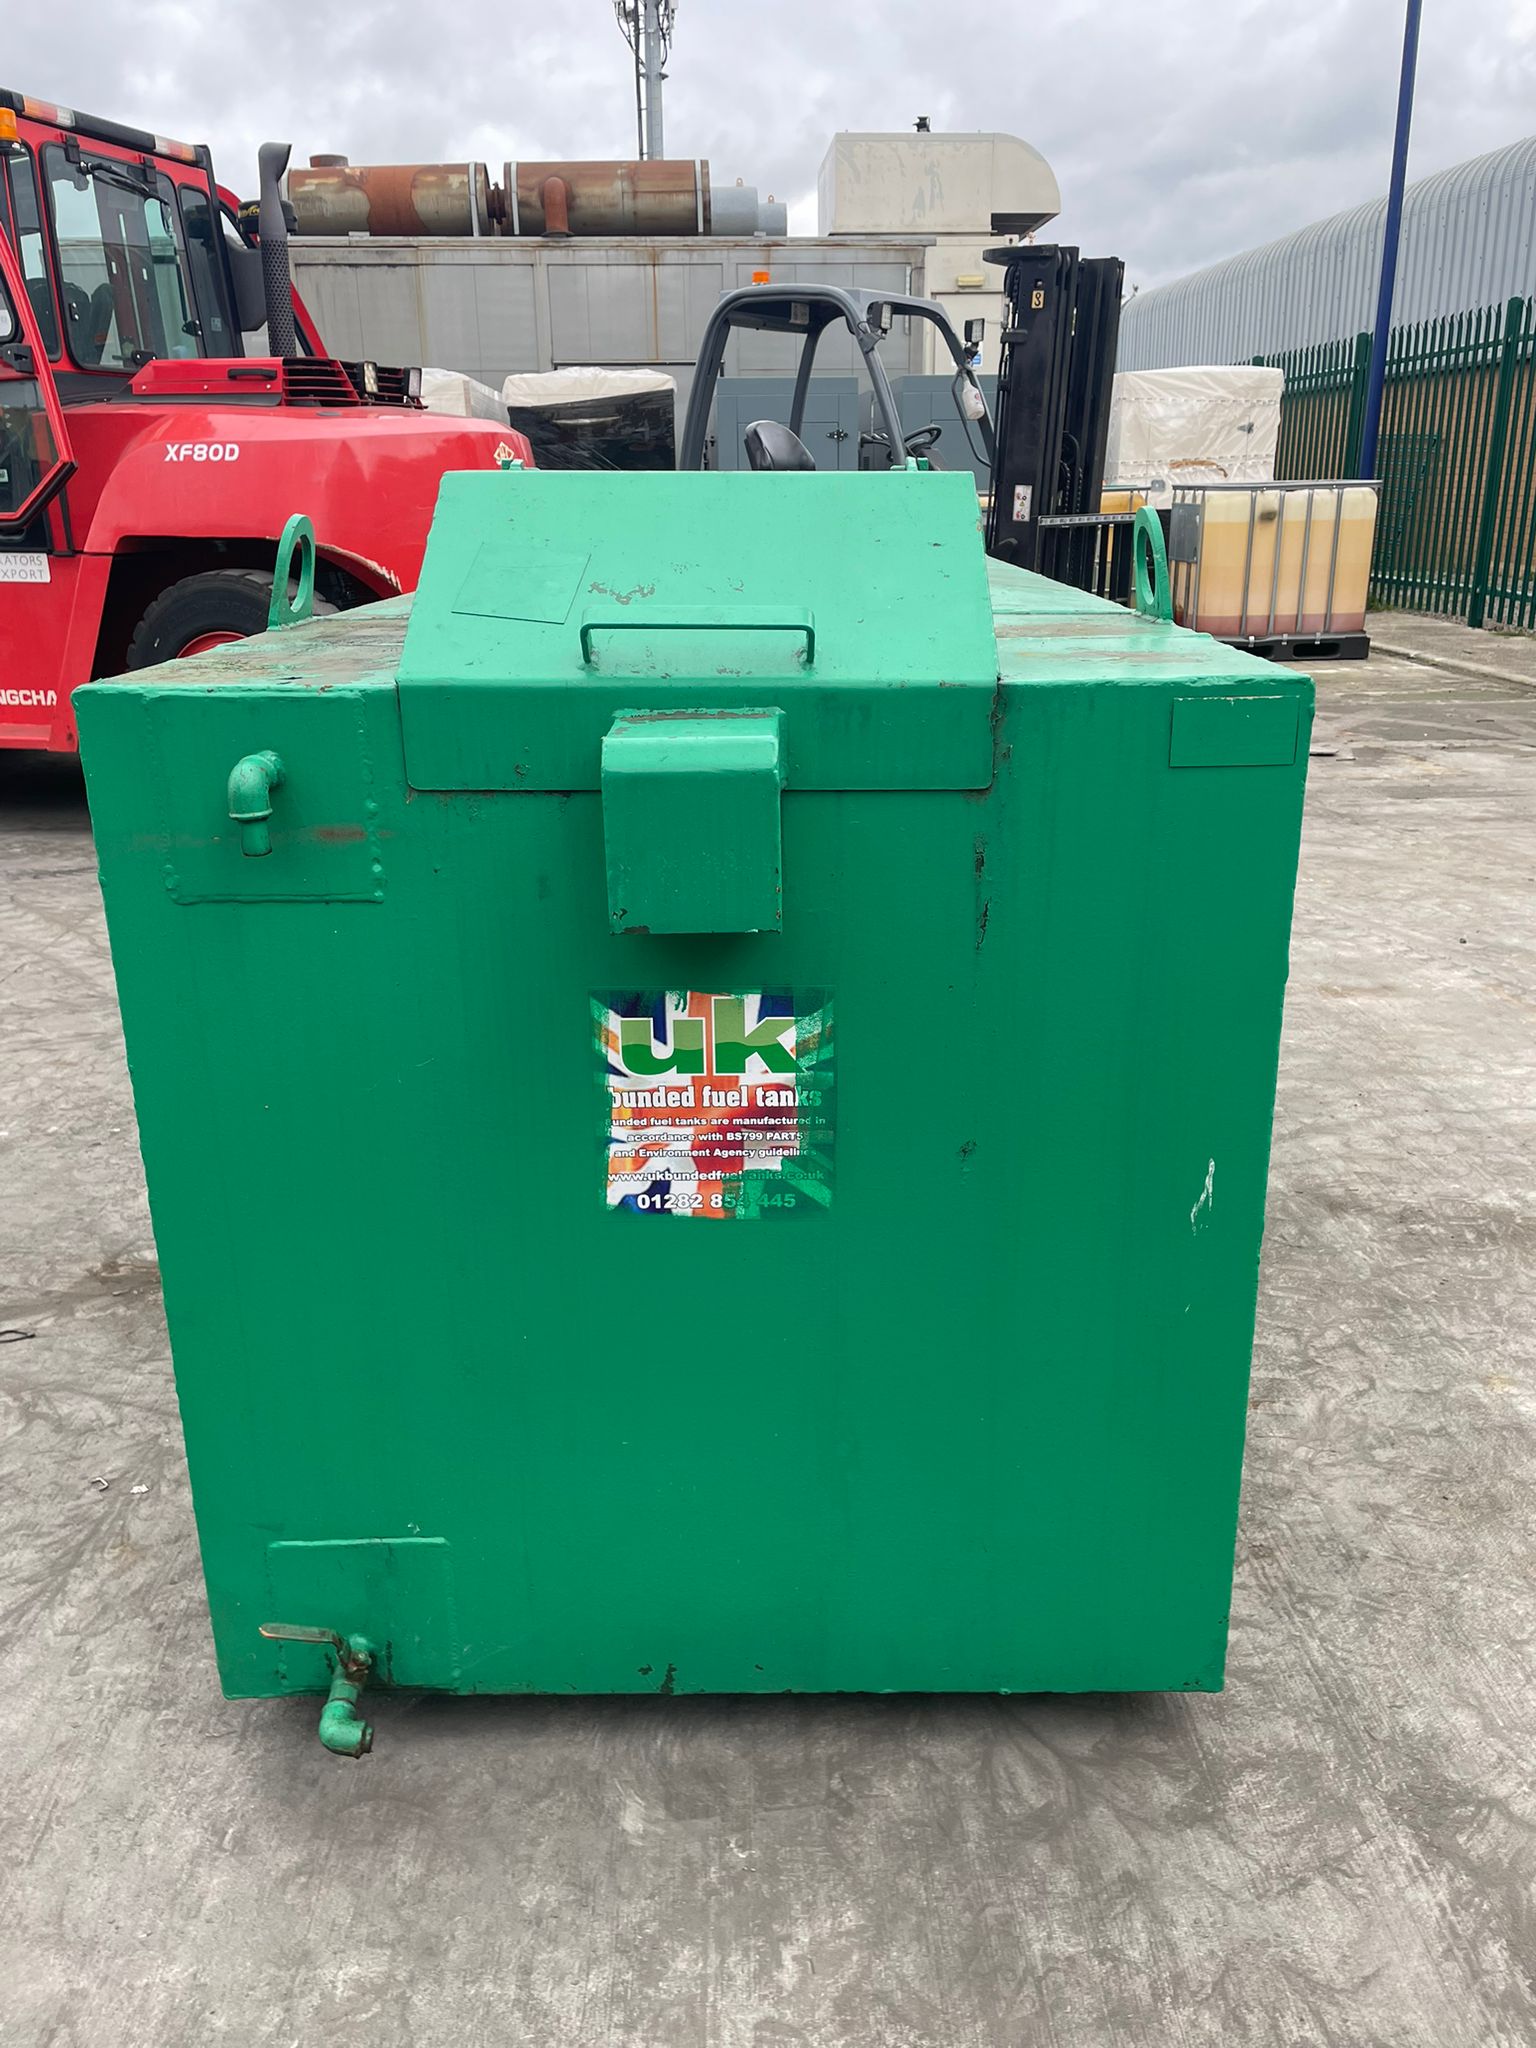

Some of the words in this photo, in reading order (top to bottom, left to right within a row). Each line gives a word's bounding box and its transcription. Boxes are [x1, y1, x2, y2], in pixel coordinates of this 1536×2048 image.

[164, 443, 240, 462] XF80D
[619, 996, 806, 1077] uk
[607, 1085, 696, 1109] bunded
[702, 1085, 749, 1108] fuel
[755, 1085, 823, 1108] tanks
[650, 1116, 672, 1127] fuel
[675, 1116, 708, 1127] tanks
[710, 1117, 730, 1127] are
[732, 1115, 811, 1126] manufactured
[627, 1132, 695, 1142] accordance
[697, 1131, 724, 1142] with
[726, 1131, 764, 1142] BS799
[614, 1148, 637, 1158] and
[638, 1147, 710, 1158] Environment
[713, 1147, 756, 1159] Agency
[608, 1168, 825, 1182] www.ukbundedfuelanks.co.uk
[637, 1193, 704, 1210] 01282
